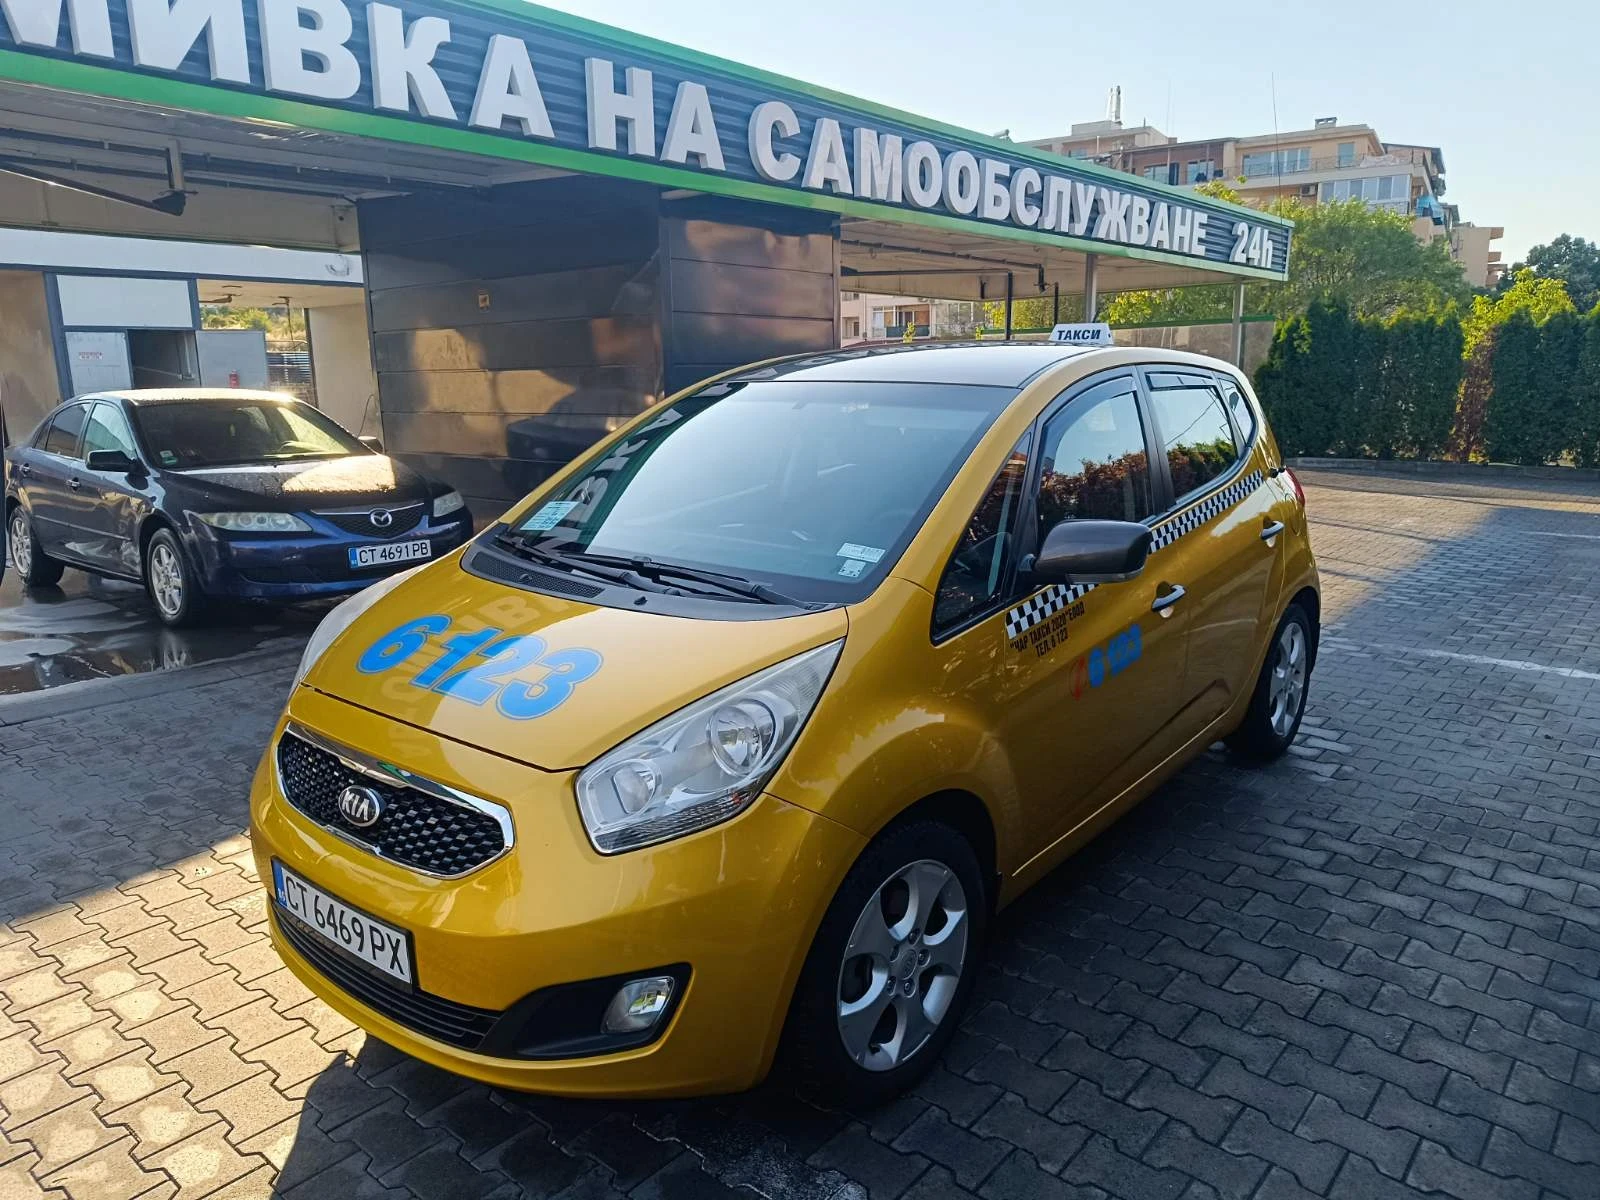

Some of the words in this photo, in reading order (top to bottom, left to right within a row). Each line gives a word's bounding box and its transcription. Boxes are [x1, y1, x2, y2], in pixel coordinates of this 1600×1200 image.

[585, 57, 726, 171] НА
[748, 101, 1208, 257] САМООБСЛУЖВАНЕ
[1229, 222, 1274, 268] 24h
[1057, 329, 1101, 341] ТАКСИ
[342, 789, 370, 822] KIA
